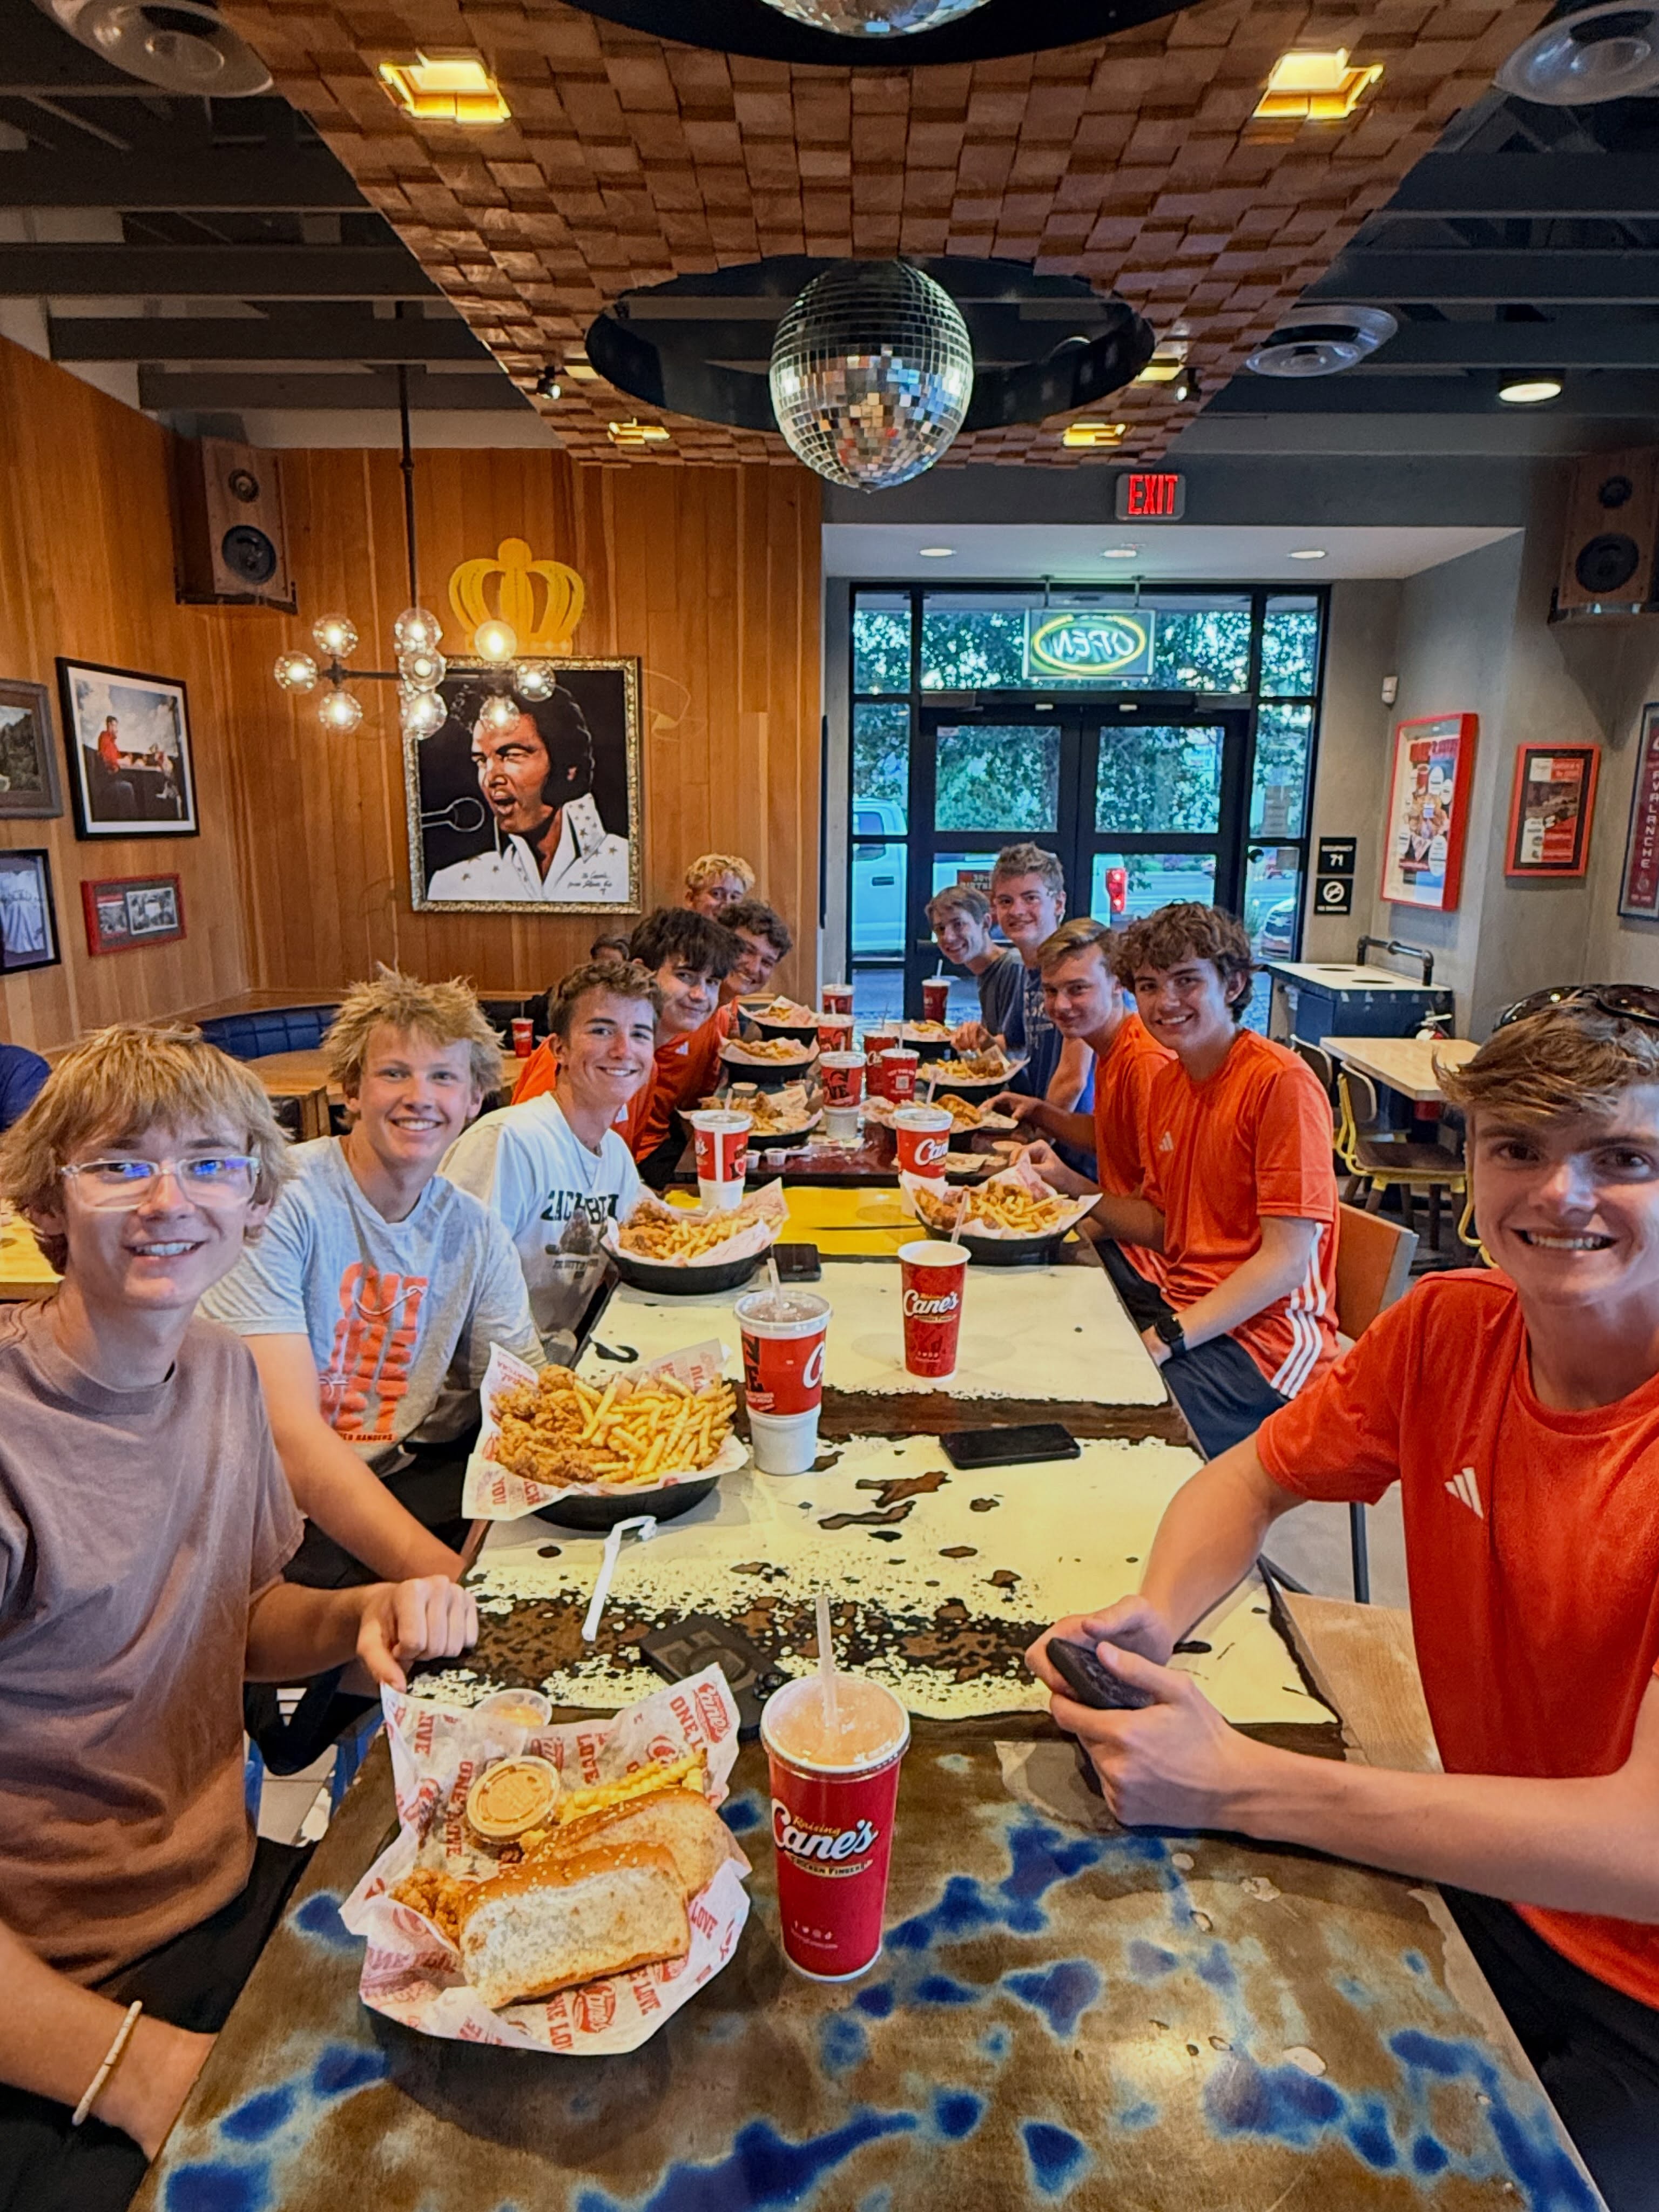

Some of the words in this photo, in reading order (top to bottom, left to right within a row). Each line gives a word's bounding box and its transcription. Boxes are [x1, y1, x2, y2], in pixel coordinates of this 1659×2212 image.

[1128, 474, 1178, 515] EXIT
[1330, 854, 1344, 867] 71
[903, 1289, 959, 1317] Cane's
[670, 1696, 698, 1741] ONE
[772, 1798, 879, 1860] Cane's
[792, 1814, 841, 1835] Raising
[691, 1901, 718, 1940] LOVE
